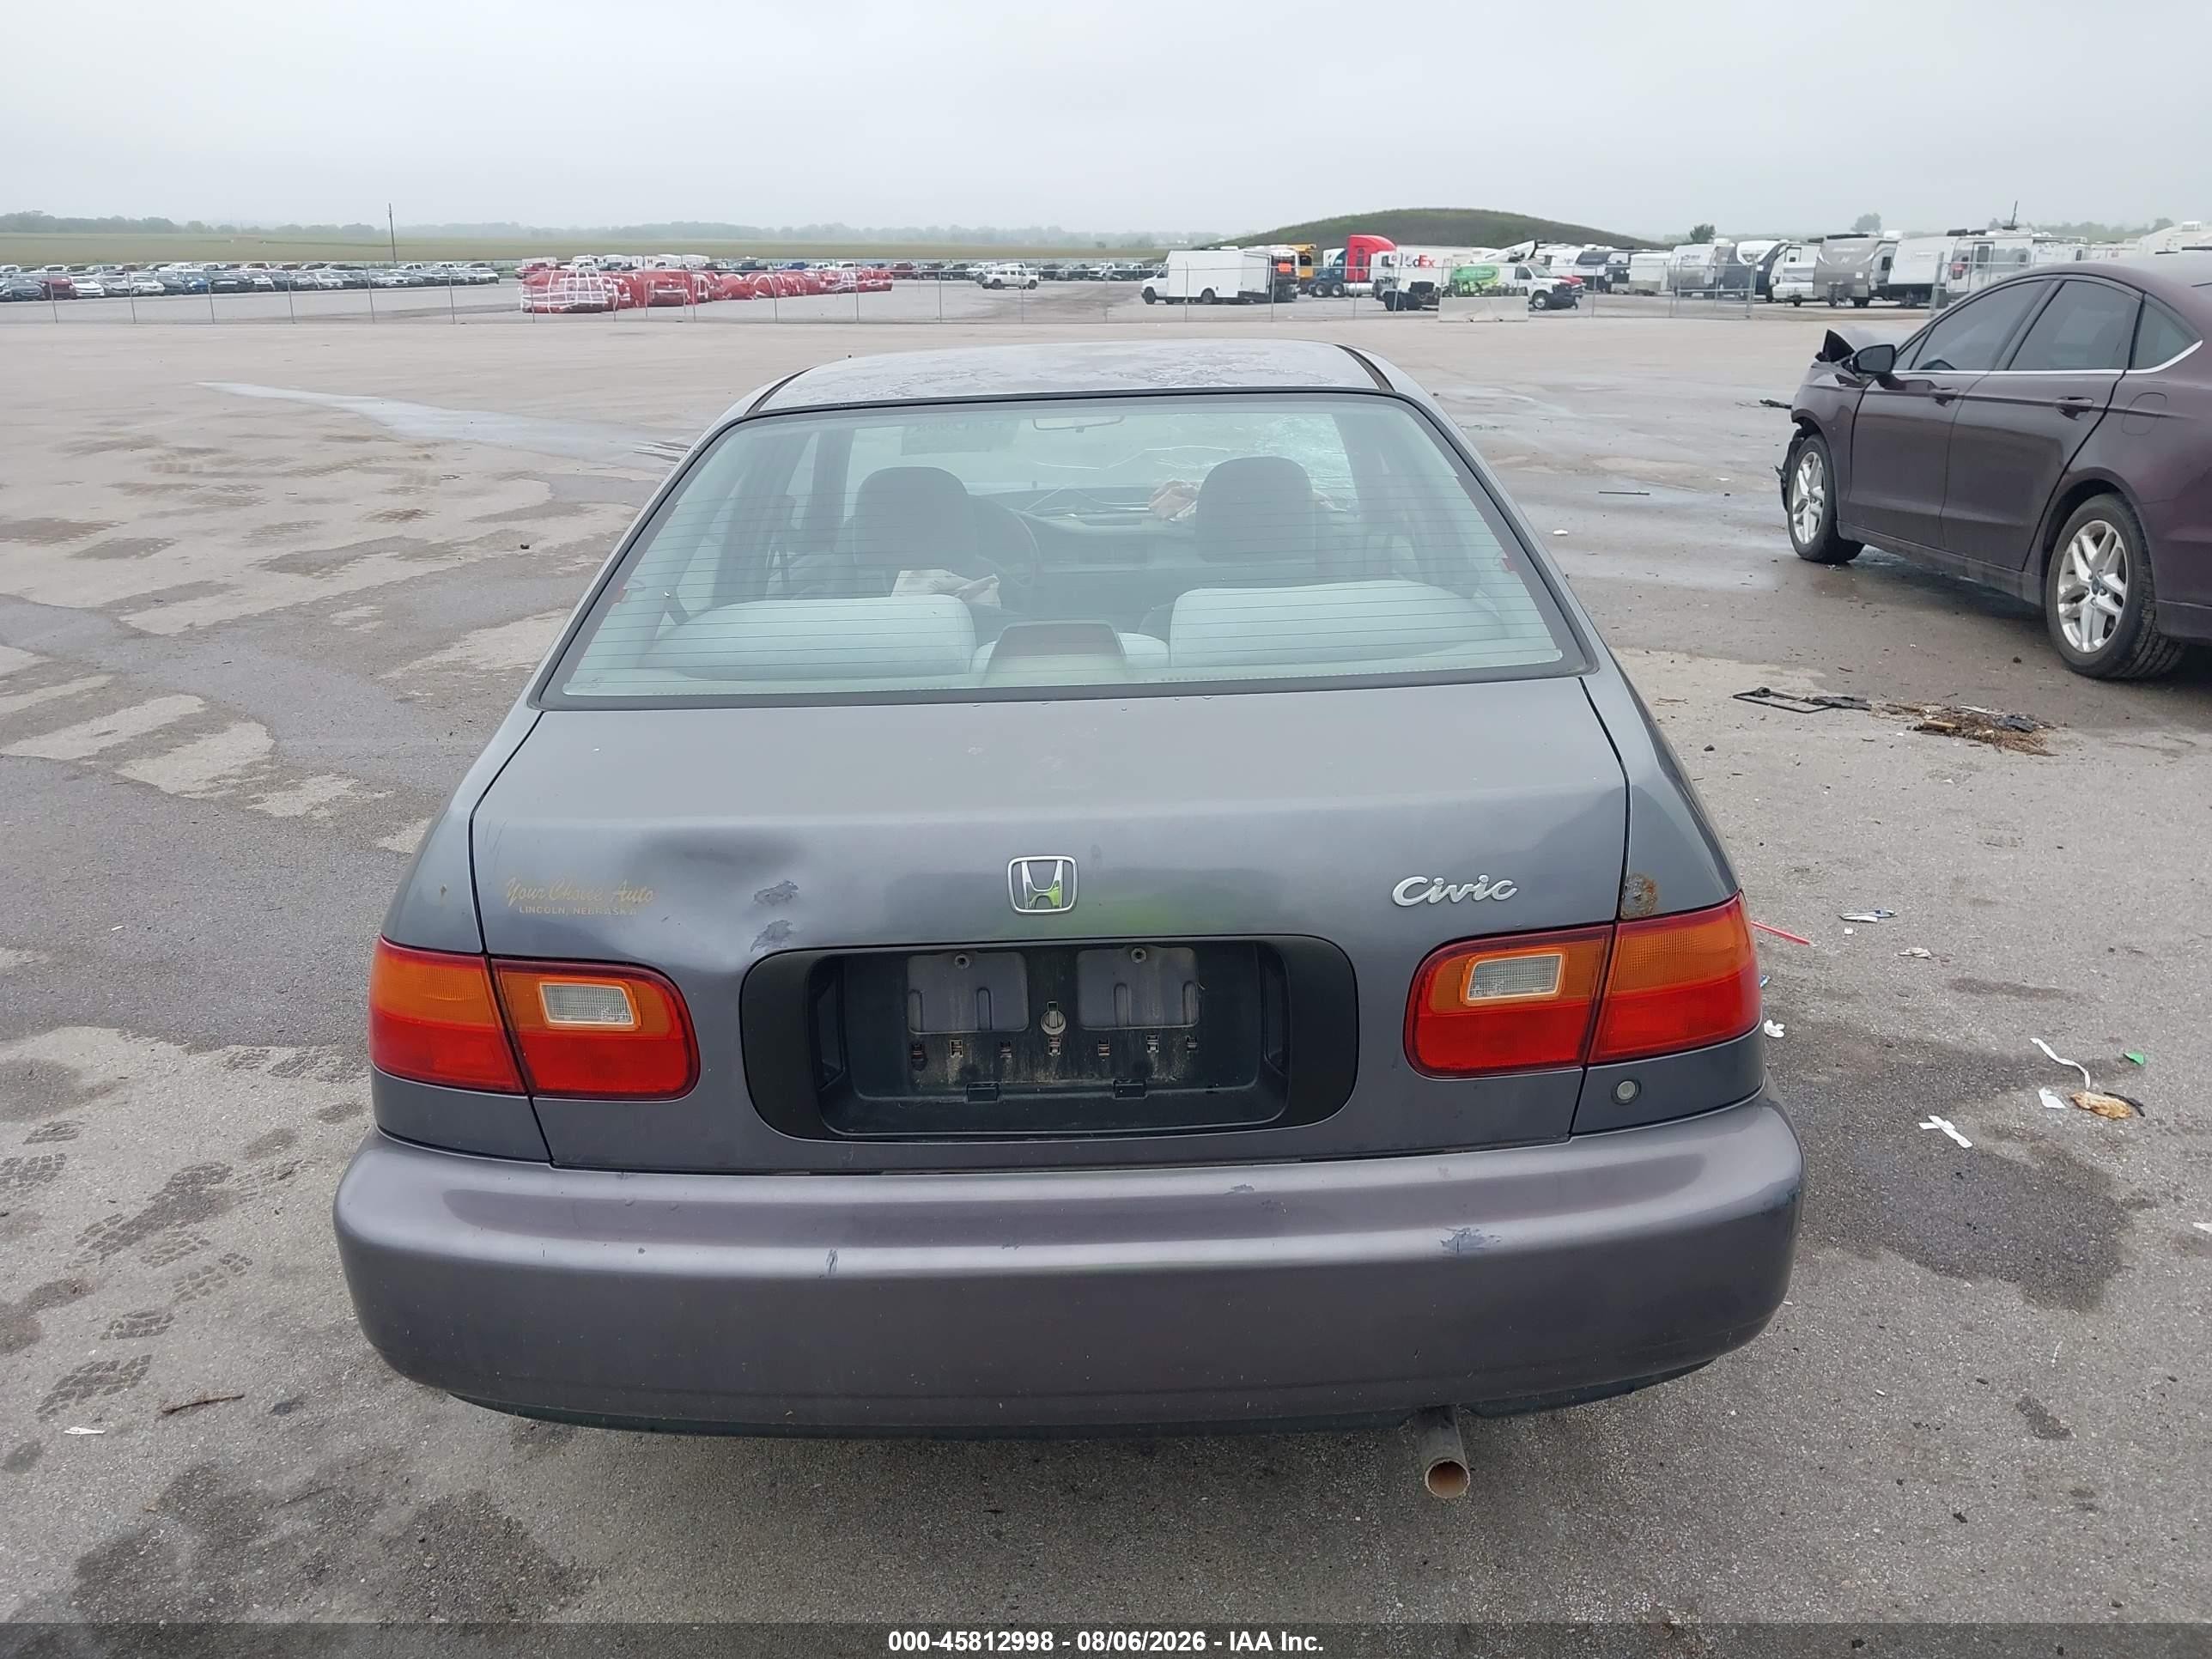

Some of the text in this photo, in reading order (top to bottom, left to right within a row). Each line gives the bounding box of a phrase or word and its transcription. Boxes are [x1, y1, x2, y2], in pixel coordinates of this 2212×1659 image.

[507, 878, 547, 907] Your
[611, 878, 656, 902] Auto
[1392, 874, 1518, 907] Civic
